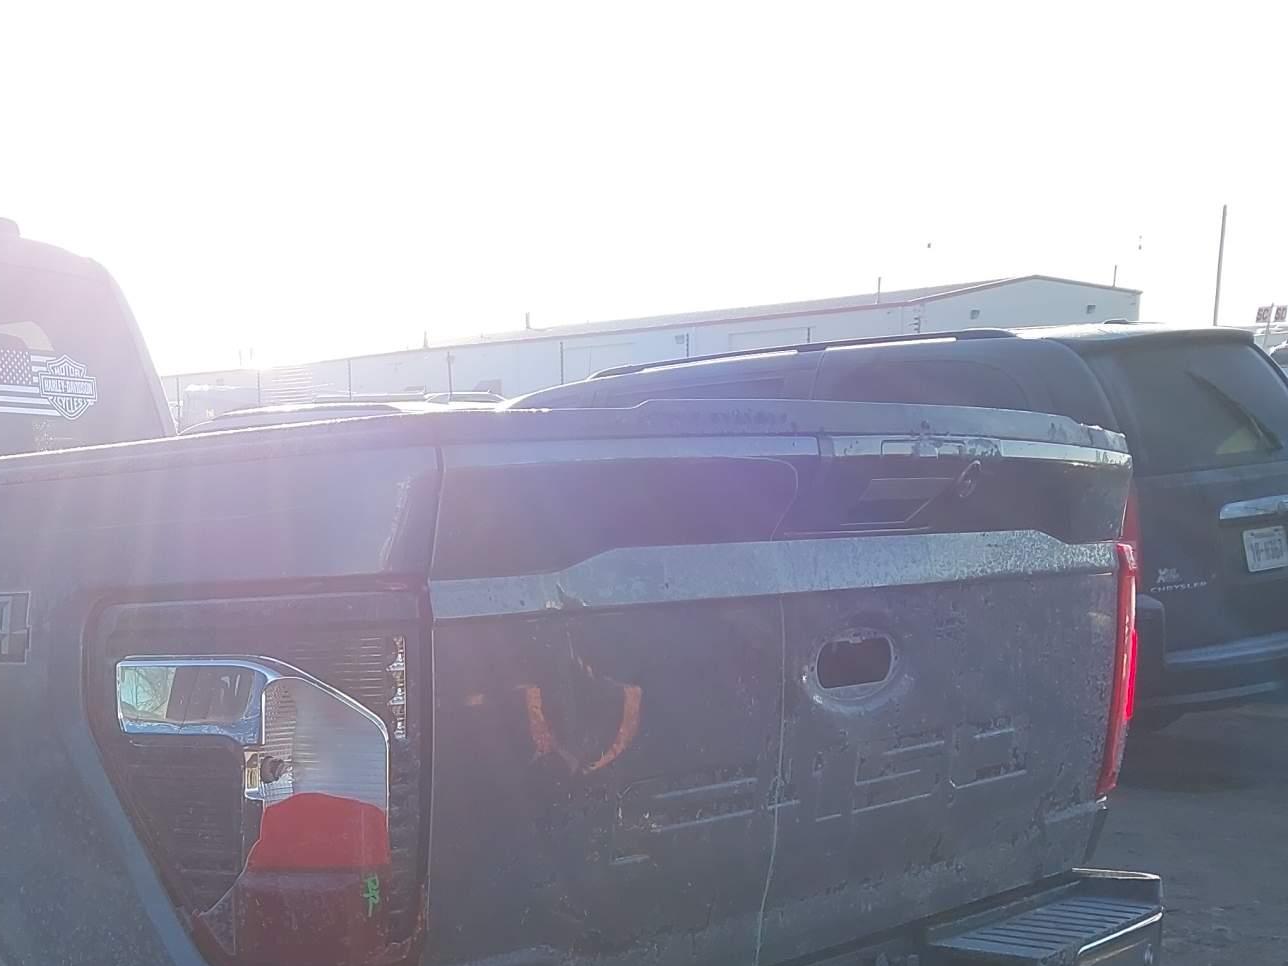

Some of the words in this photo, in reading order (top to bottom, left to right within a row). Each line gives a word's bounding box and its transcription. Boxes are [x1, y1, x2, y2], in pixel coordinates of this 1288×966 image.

[53, 363, 82, 377] MOTOR
[44, 379, 93, 395] HARLEY-DAVIDSON
[56, 396, 86, 412] CYCLES
[1150, 580, 1207, 592] CHRYSLER
